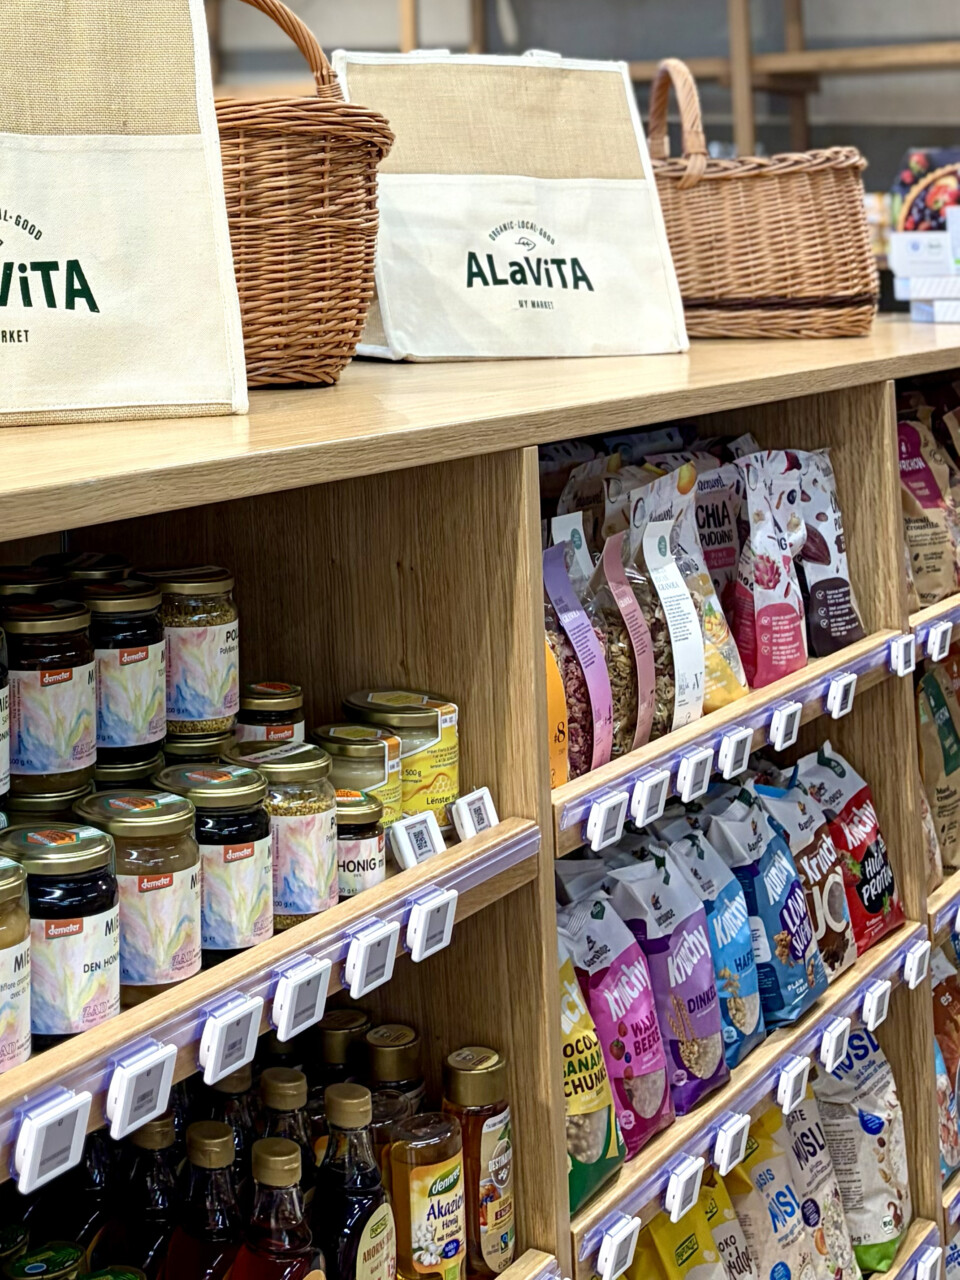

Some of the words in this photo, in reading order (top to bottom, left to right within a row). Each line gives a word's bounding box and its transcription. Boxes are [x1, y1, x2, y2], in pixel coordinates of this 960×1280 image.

[518, 299, 528, 309] MY
[531, 300, 554, 310] MARKET
[695, 500, 732, 530] CHIA
[699, 529, 733, 547] PUDDING
[141, 875, 170, 890] demeter
[48, 923, 80, 936] demeter
[83, 960, 101, 974] DEN
[667, 925, 712, 988] Krunchy
[603, 955, 652, 1022] Krunchy
[687, 984, 717, 1014] DINKEL
[630, 1009, 656, 1039] WALD
[633, 1026, 660, 1057] BEERE
